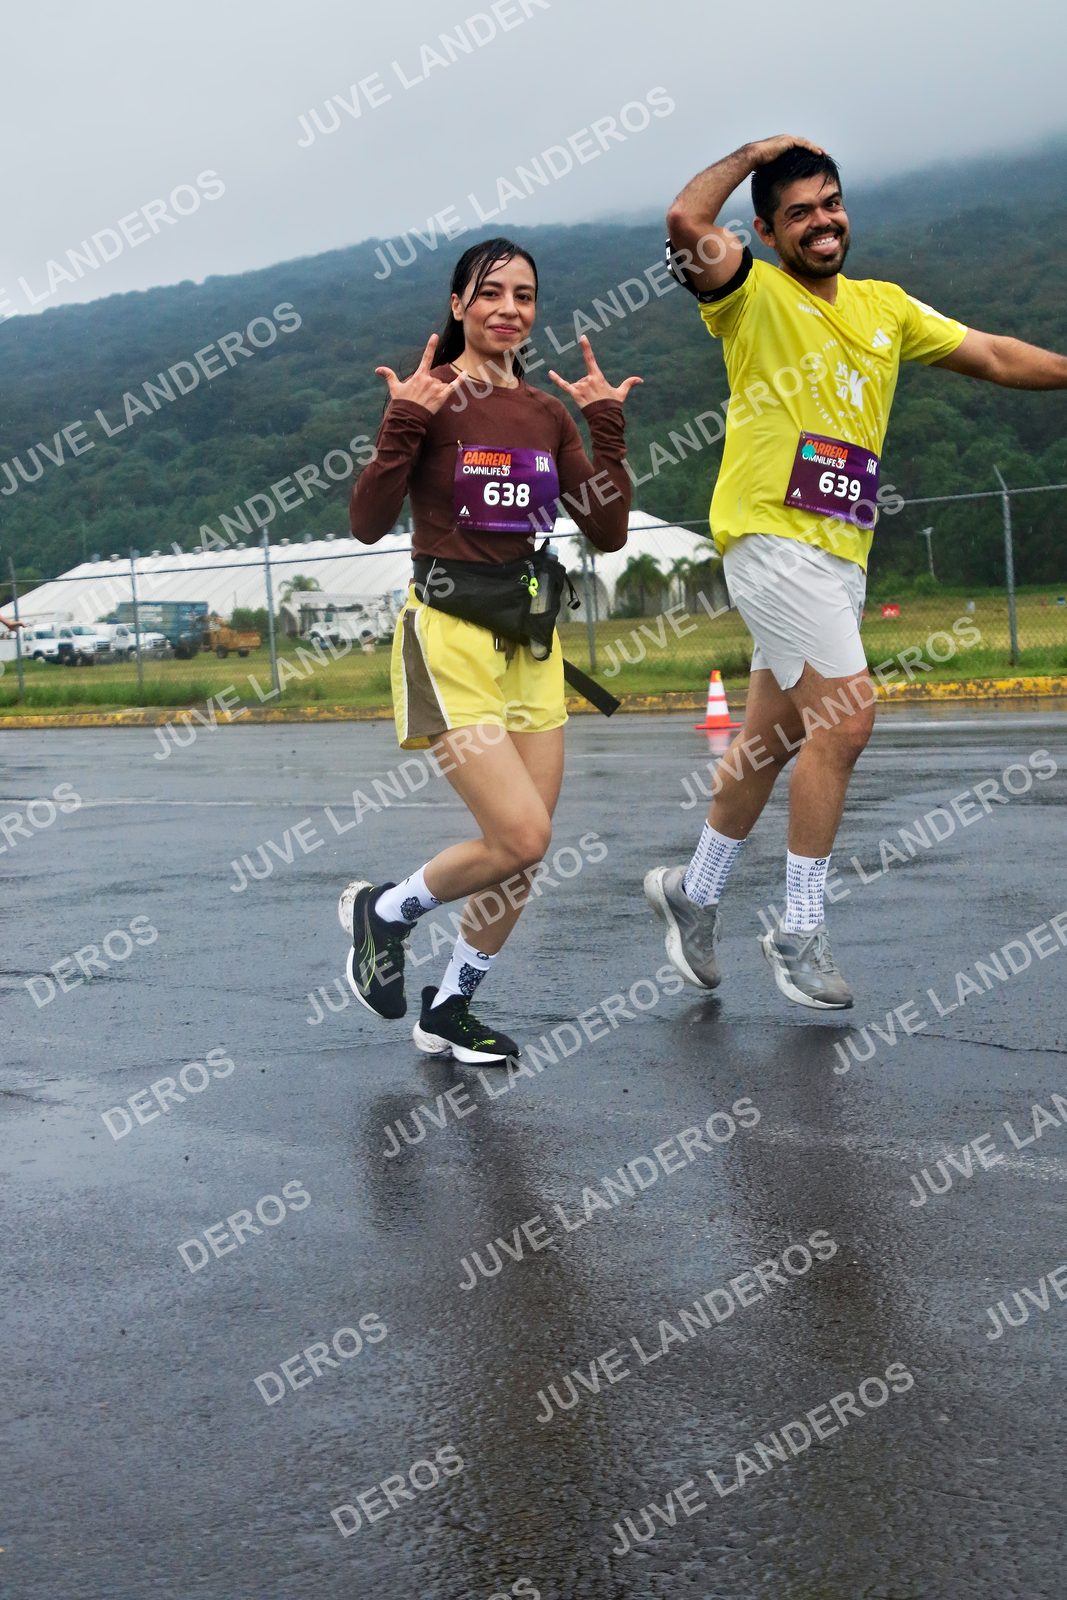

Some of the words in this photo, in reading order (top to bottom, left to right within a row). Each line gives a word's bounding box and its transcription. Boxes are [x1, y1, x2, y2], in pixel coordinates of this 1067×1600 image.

[463, 451, 512, 466] CARRERA
[462, 466, 500, 476] OMNILIFE
[484, 482, 530, 507] 638
[819, 472, 860, 502] 639
